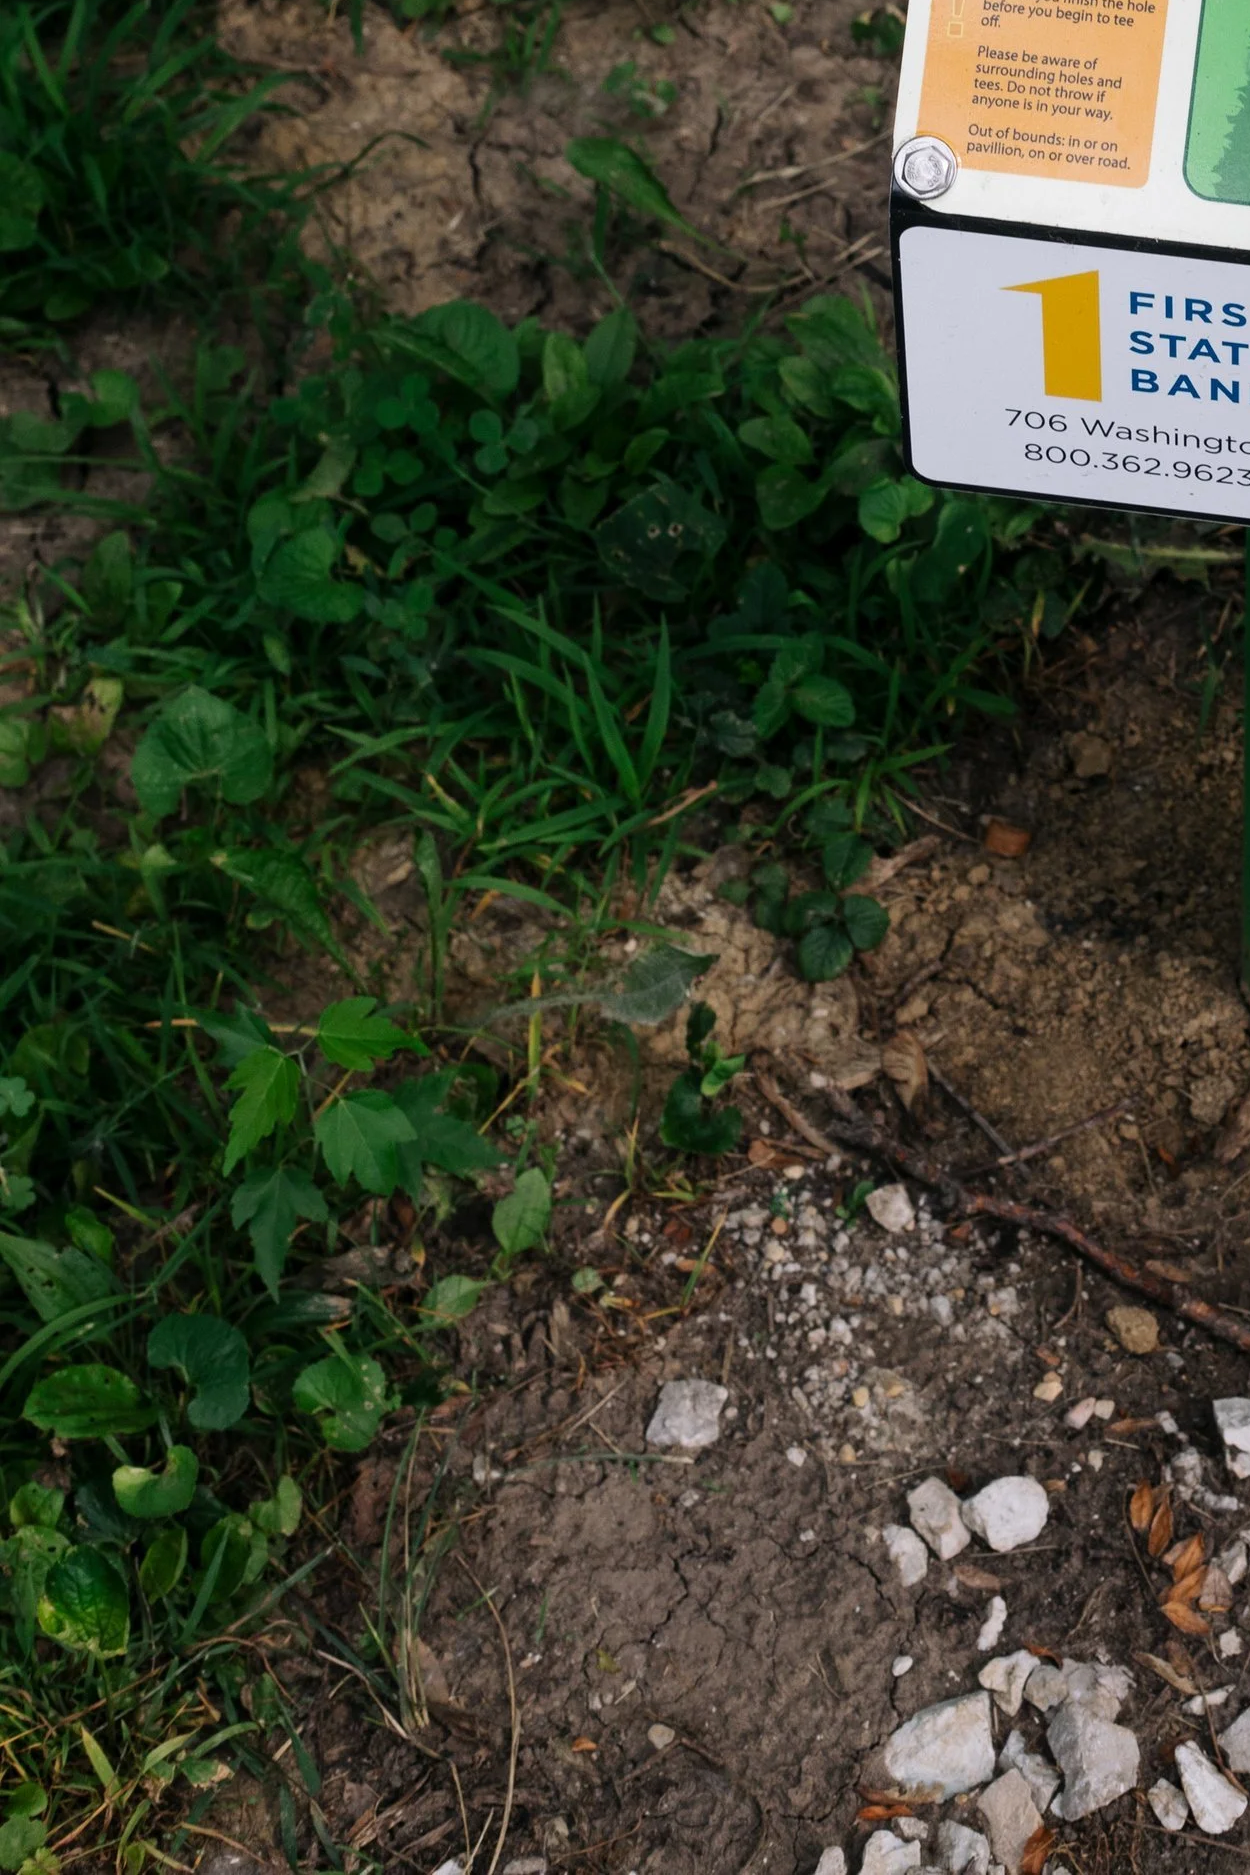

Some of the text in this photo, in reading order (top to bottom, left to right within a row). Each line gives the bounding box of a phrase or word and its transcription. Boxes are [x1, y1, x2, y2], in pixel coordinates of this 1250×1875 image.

[1028, 6, 1052, 19] you
[1056, 7, 1093, 23] begin
[1096, 13, 1110, 24] to
[1113, 15, 1134, 27] tee
[1127, 0, 1156, 14] hole
[981, 15, 1001, 28] off.
[977, 45, 1099, 70] Please be aware of
[975, 63, 1122, 89] surrounding holes and
[974, 78, 1107, 103] tees. Do not throw if
[971, 94, 1113, 122] anyone is in your way.
[968, 123, 1118, 153] Out of bounds: in or on
[966, 141, 1131, 170] pavillion, on or over road.
[1004, 408, 1068, 433] 706
